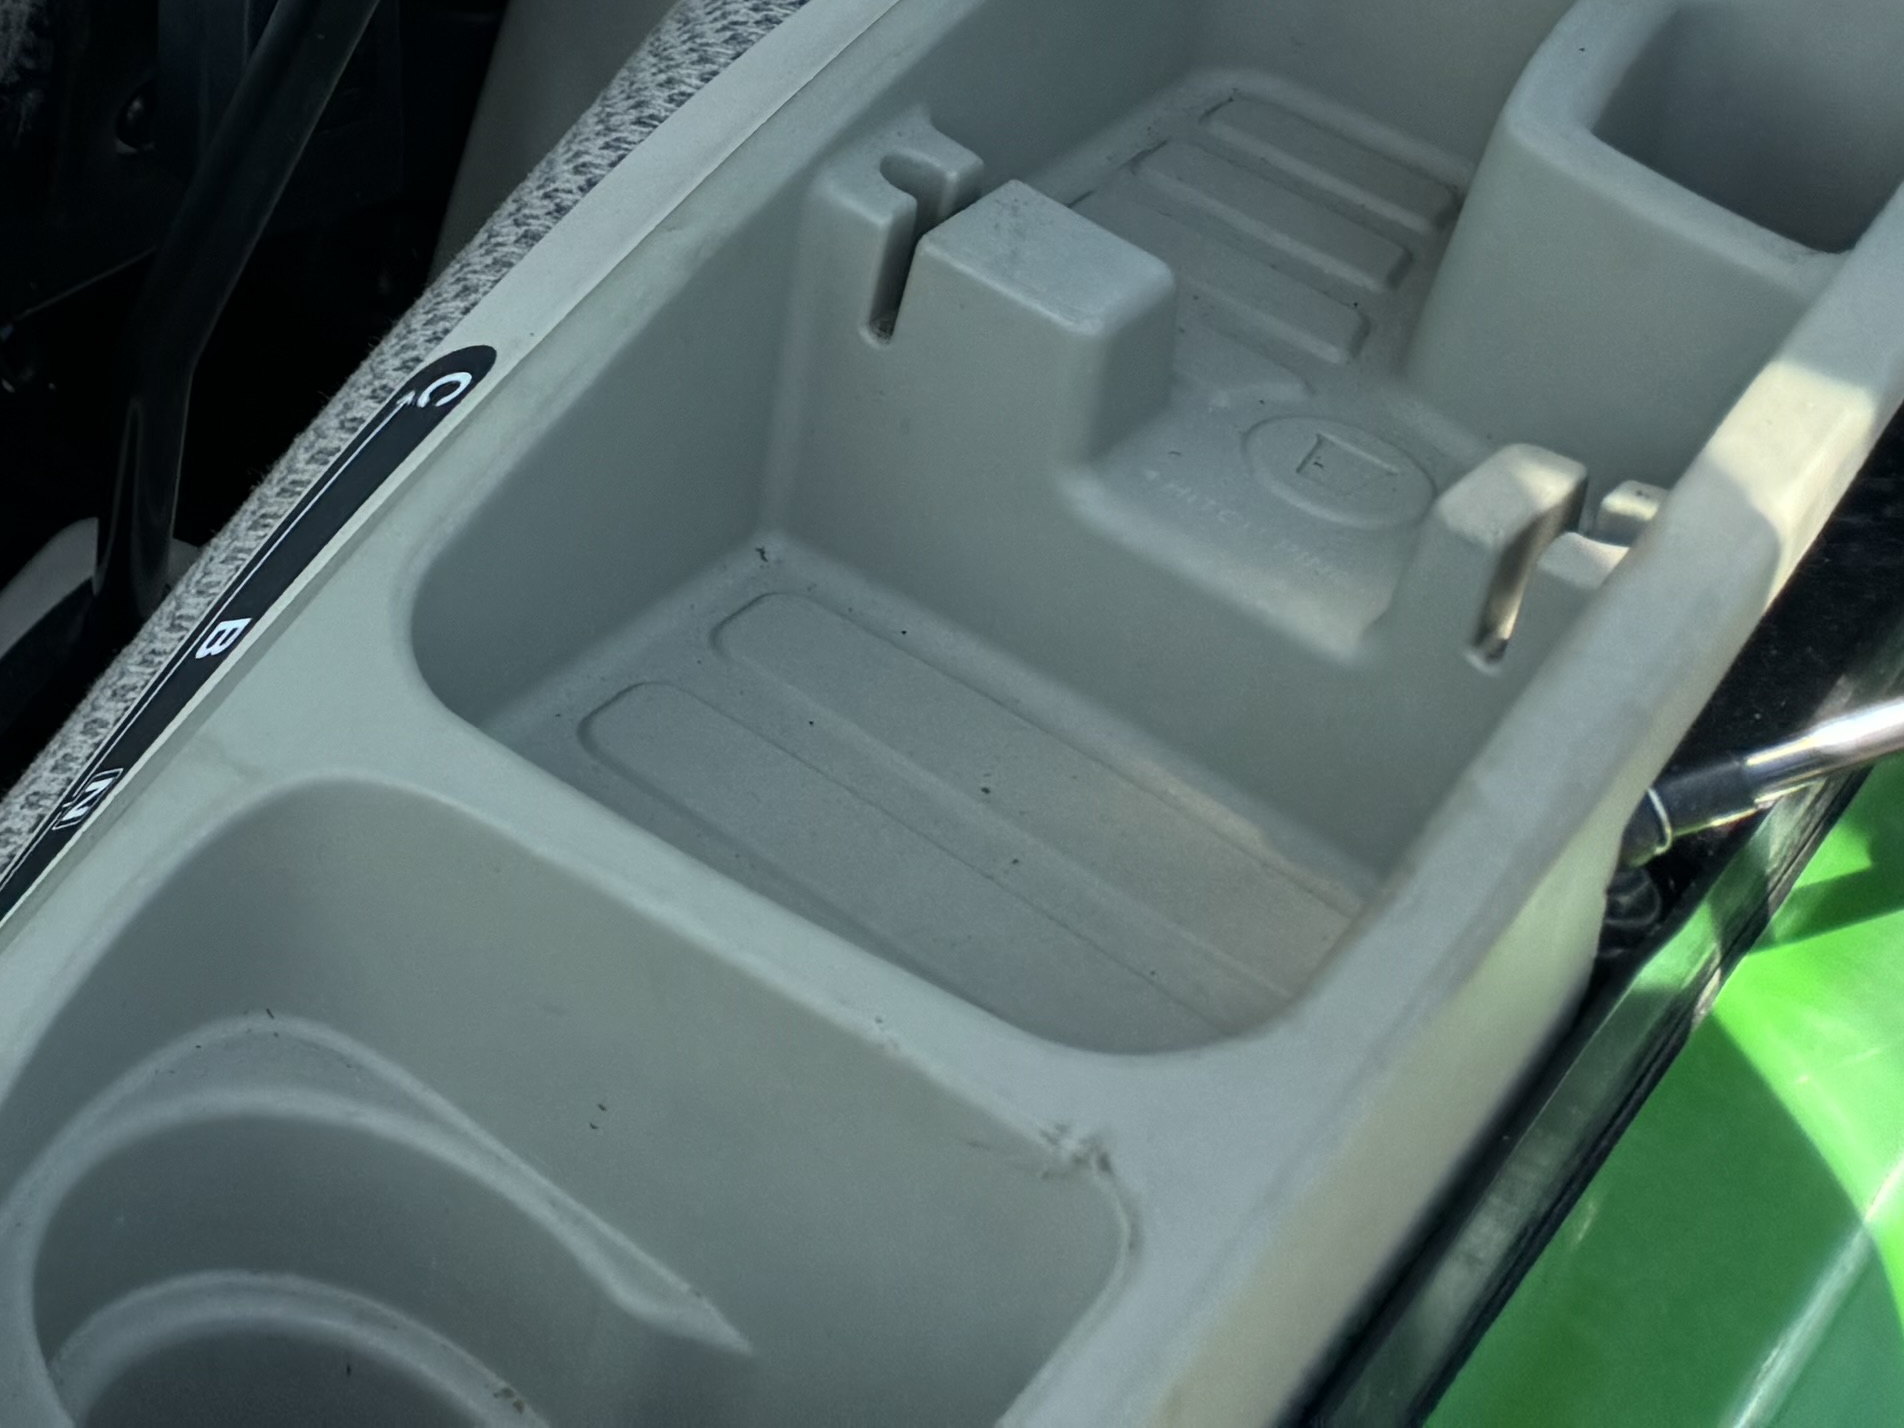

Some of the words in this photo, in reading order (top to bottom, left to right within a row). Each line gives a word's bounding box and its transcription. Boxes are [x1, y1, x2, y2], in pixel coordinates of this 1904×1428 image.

[416, 371, 473, 408] C
[195, 617, 253, 660] B
[60, 777, 115, 821] N
